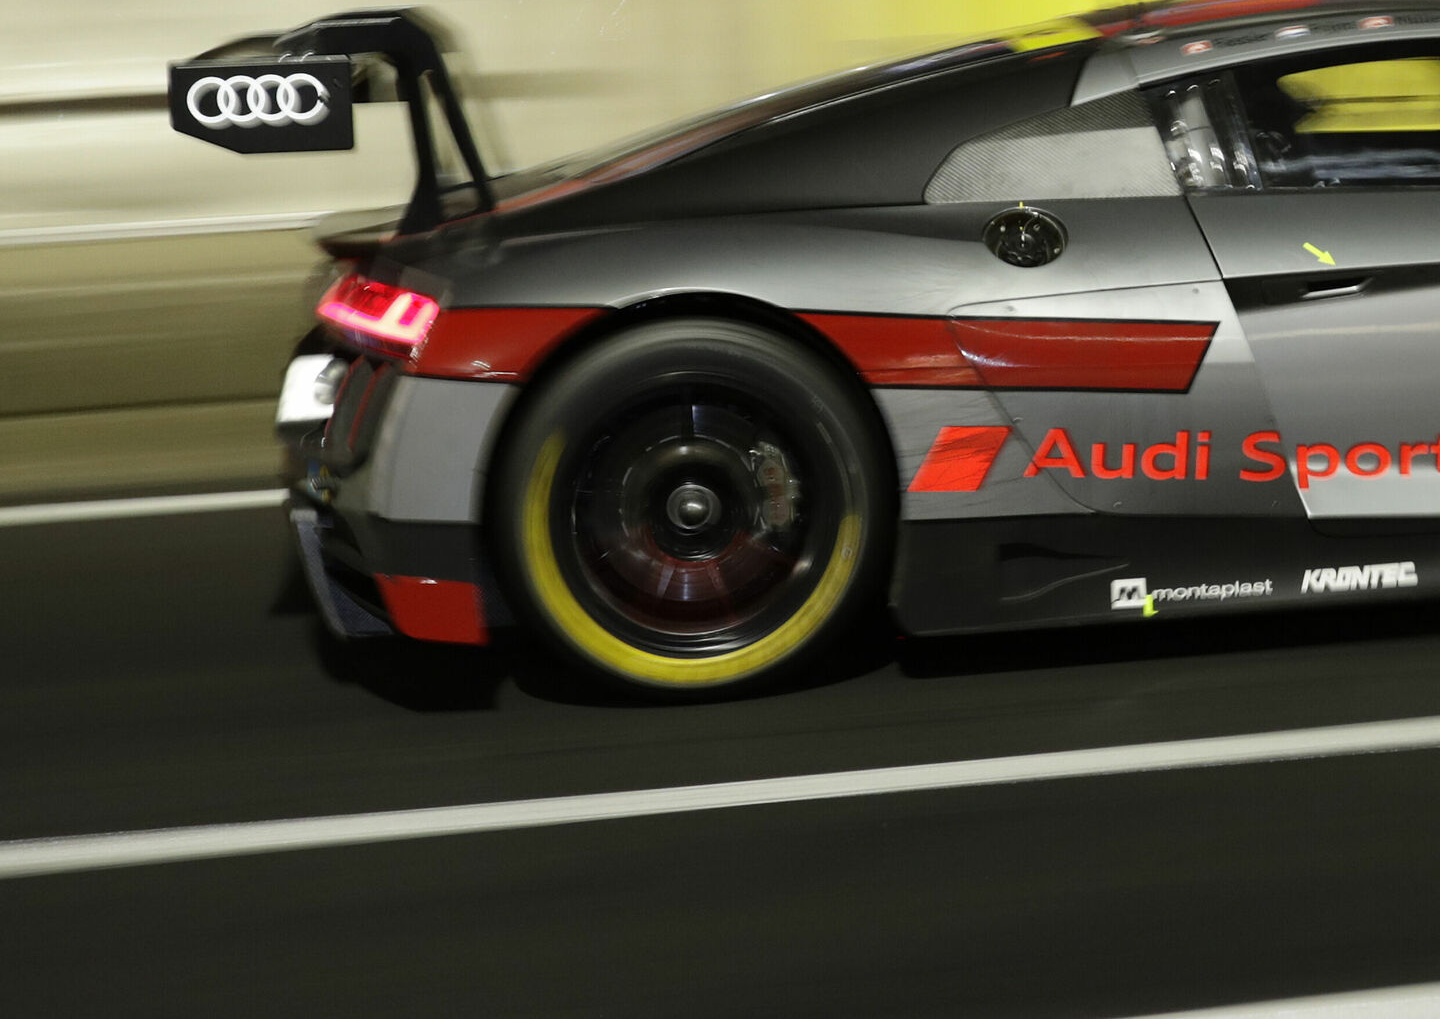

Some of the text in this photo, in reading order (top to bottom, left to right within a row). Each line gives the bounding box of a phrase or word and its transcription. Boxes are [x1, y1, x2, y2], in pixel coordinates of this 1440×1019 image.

[1023, 427, 1211, 480] Audi
[1151, 579, 1273, 602] montaplast
[1301, 561, 1418, 594] KRONTEC
